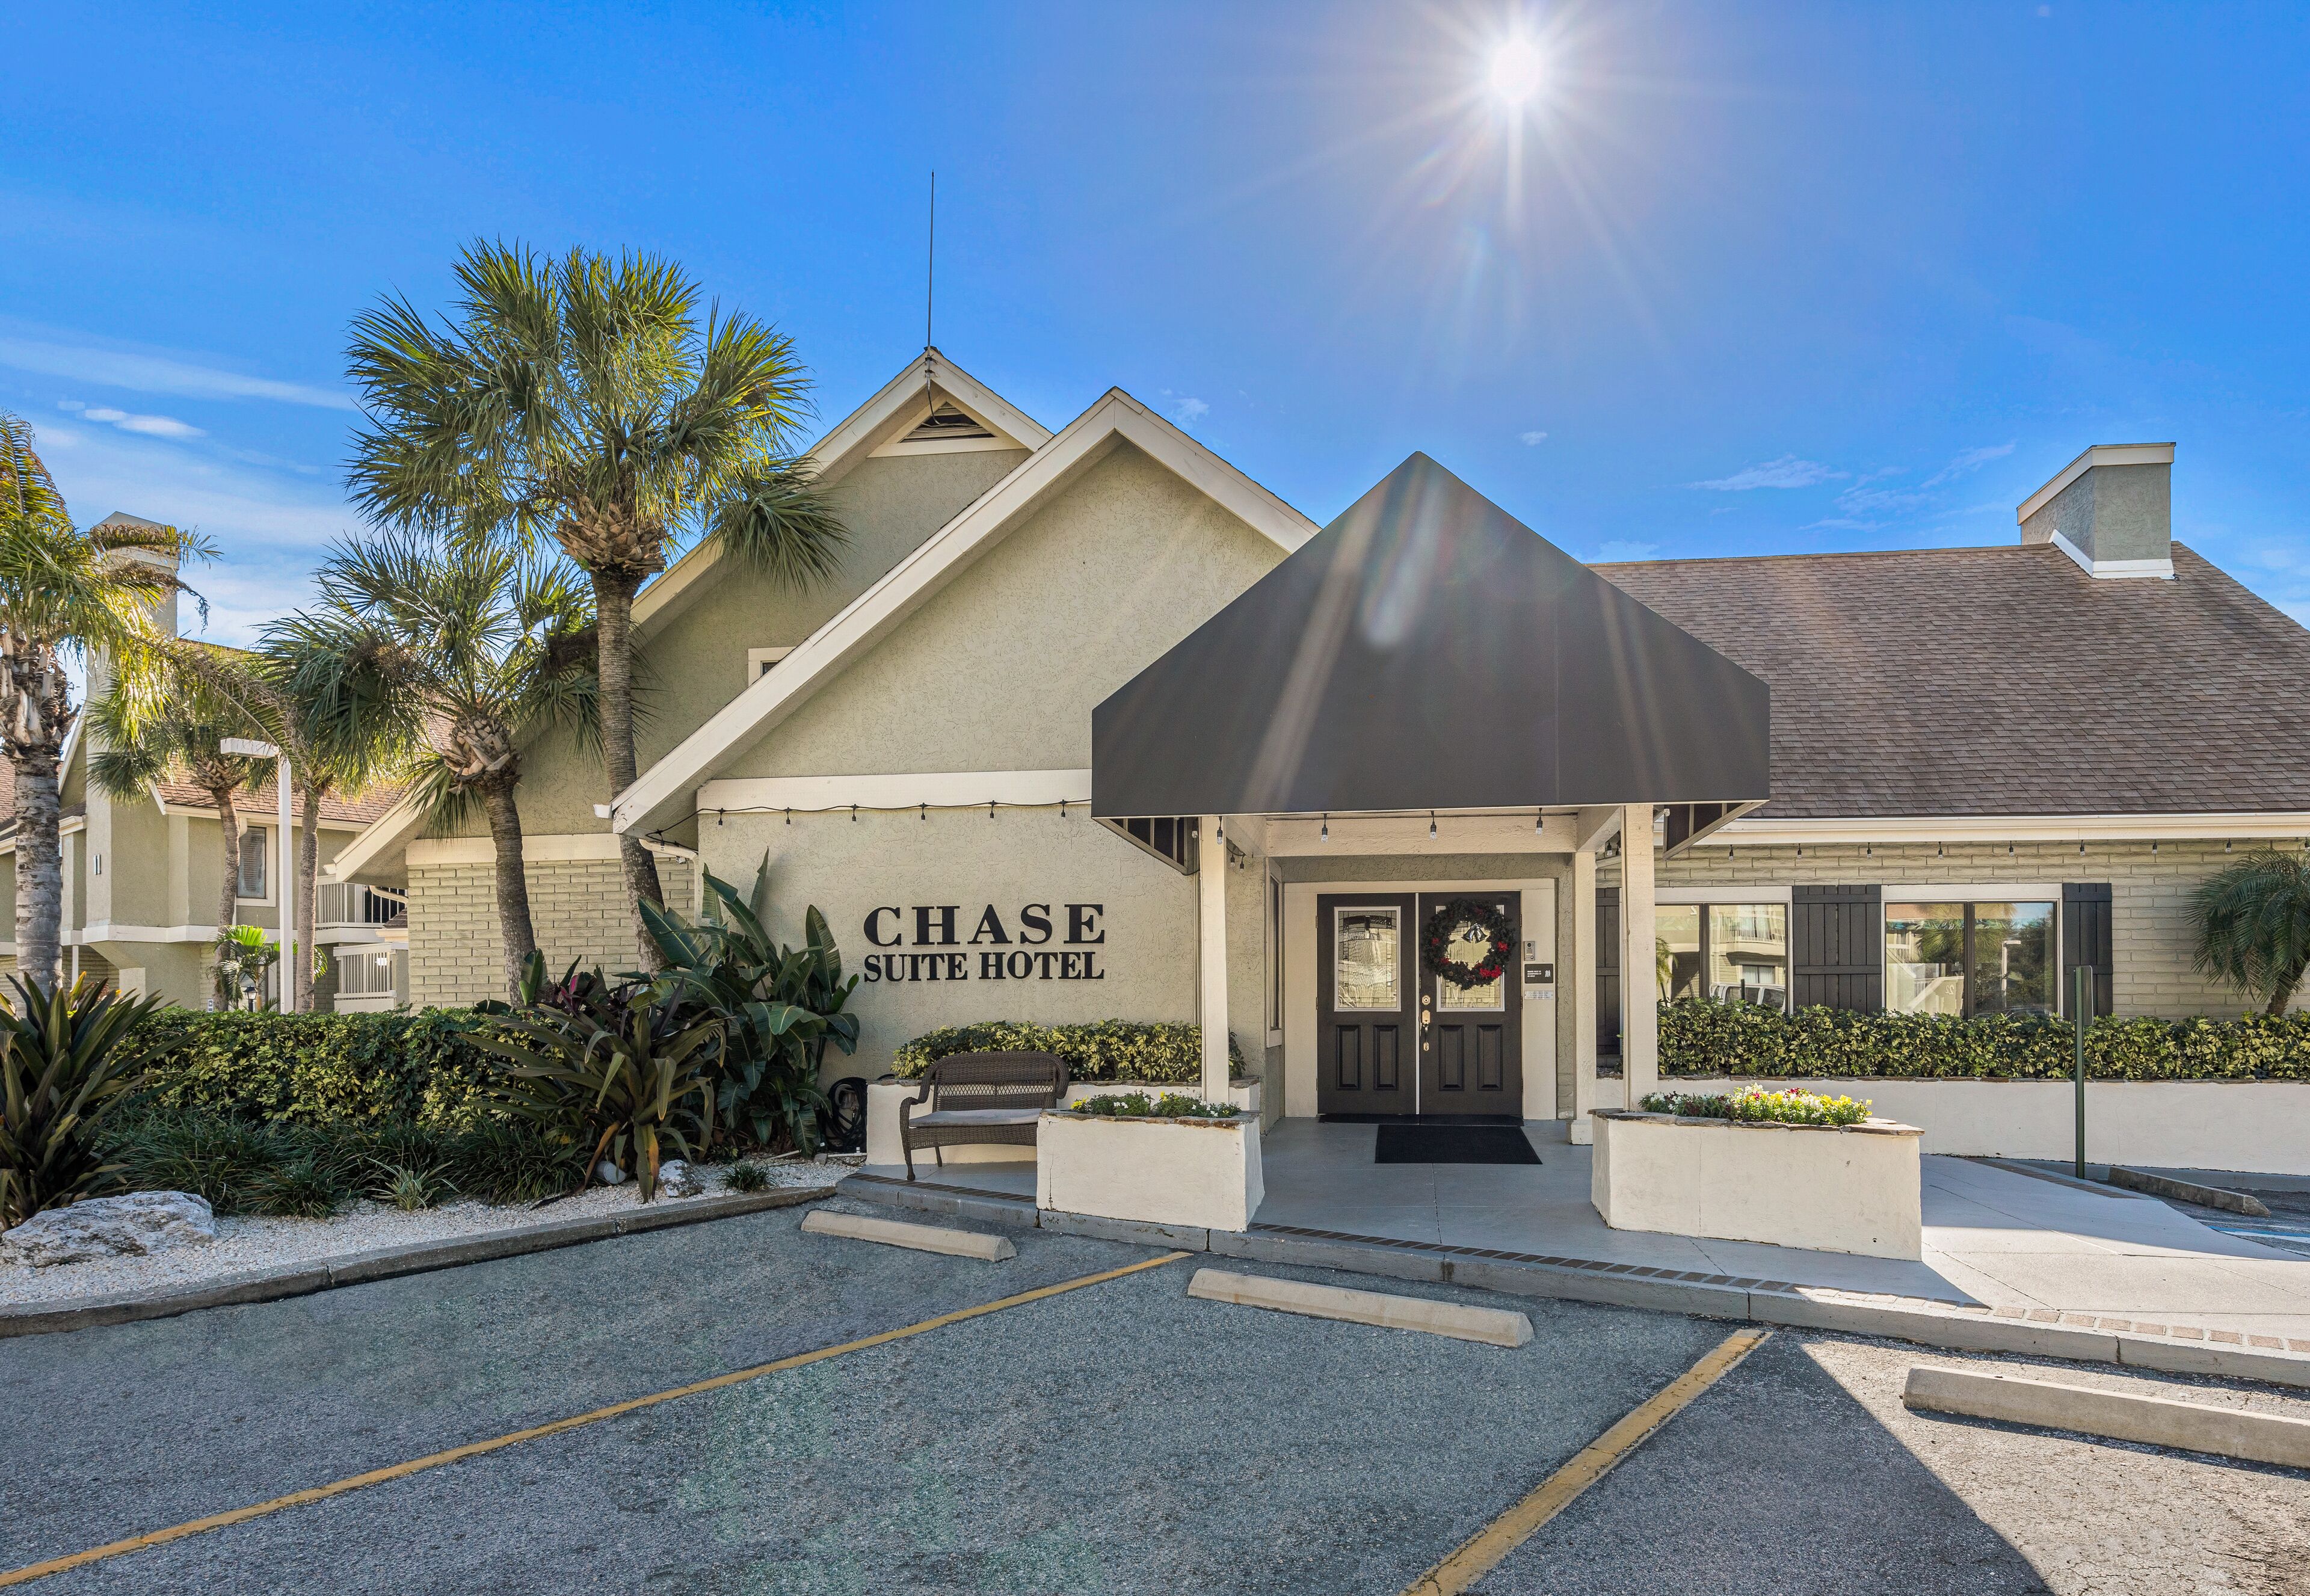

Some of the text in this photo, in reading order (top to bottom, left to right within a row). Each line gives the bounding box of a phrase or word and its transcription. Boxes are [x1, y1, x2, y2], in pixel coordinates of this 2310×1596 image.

[863, 904, 1105, 947] CHASE
[864, 951, 1104, 982] SUITE HOTEL
